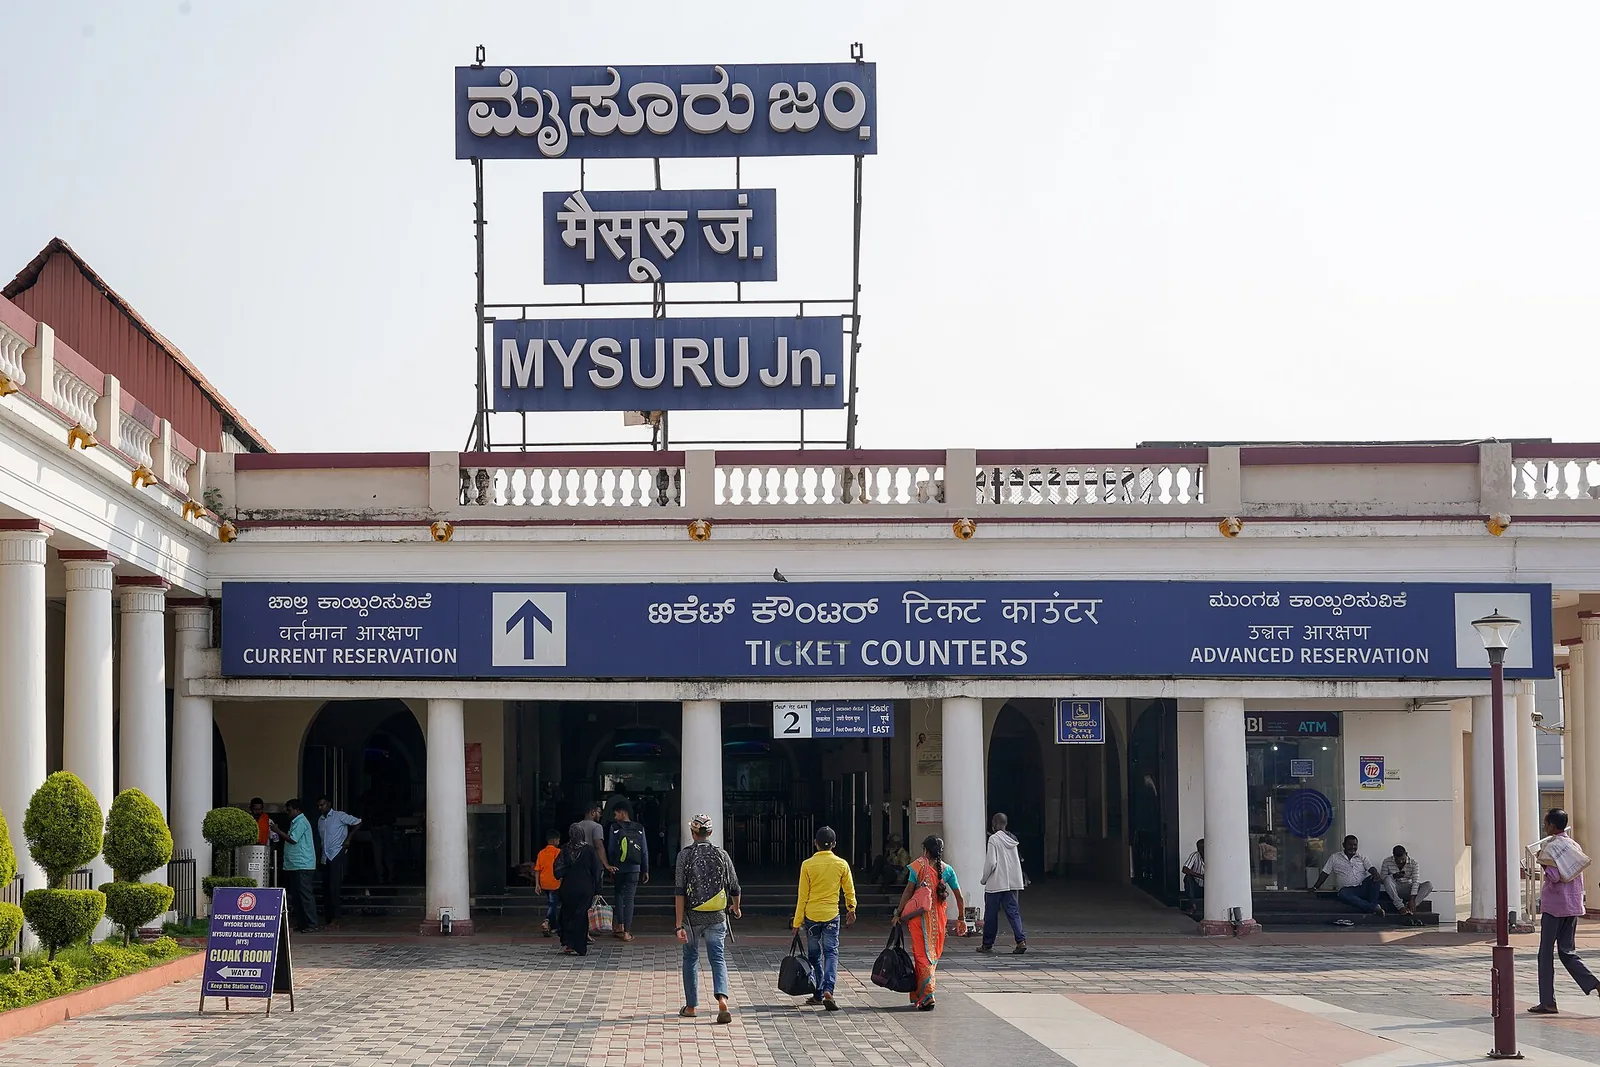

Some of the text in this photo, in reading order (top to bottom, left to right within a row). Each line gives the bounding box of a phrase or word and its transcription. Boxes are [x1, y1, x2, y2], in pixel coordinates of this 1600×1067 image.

[467, 66, 755, 157] ಮೈಸೂರು
[557, 190, 764, 282] मैसूरु जं.
[501, 336, 835, 389] MYSURU Jn.
[269, 593, 431, 616] ಚಾಲ್ತಿ ಕಾಯ್ದಿರಿಸುವಿಕೆ
[649, 596, 878, 623] ಟಿಕೆಟ್ ಕೌಂಟರ್
[902, 591, 1102, 624] टिकट काउंटर
[1210, 592, 1406, 615] ಮುಂಗಡ ಕಾಯ್ದಿರಿಸುವಿಕೆ
[280, 620, 422, 641] वर्तमान आरक्षण
[1248, 626, 1371, 640] उन्नत आरक्षण
[244, 649, 456, 663] CURRENT RESERVATION
[745, 640, 1027, 665] TICKET COUNTERS
[1191, 648, 1428, 663] ADVANCED RESERVATION
[783, 711, 801, 734] 2
[872, 726, 890, 734] EAST
[1244, 717, 1263, 732] BI
[1298, 721, 1327, 732] ATM
[1366, 766, 1379, 776] 112
[210, 949, 272, 963] CLOAK ROOM
